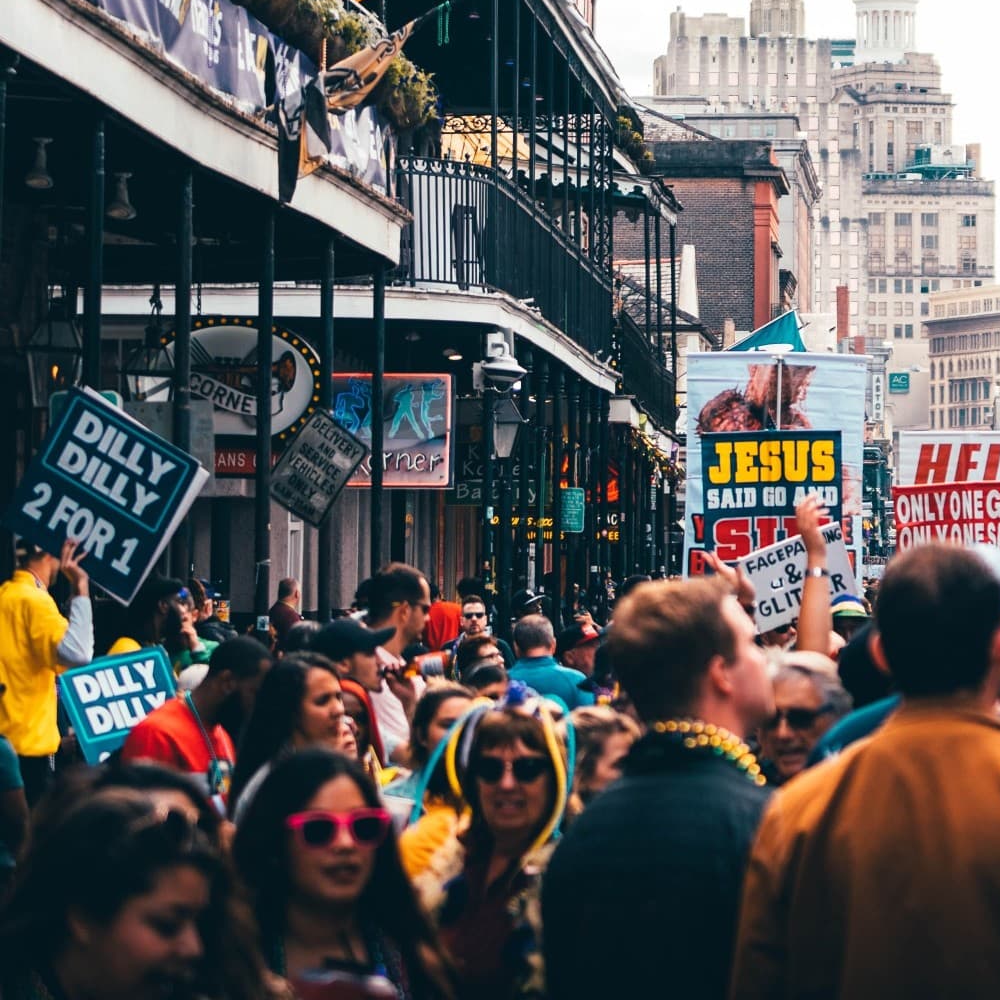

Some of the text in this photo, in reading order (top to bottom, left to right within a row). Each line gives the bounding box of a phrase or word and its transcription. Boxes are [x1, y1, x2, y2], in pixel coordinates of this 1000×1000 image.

[190, 373, 253, 414] CORNE
[892, 375, 908, 384] AC
[72, 410, 176, 485] DILLY
[311, 417, 359, 459] DELIVERY
[318, 442, 336, 459] AND
[57, 441, 160, 516] DILLY
[288, 451, 336, 497] VEHICLES
[299, 442, 341, 479] SERVICE
[708, 440, 835, 484] JESUS
[287, 474, 315, 499] ONLY
[707, 487, 757, 509] SAID
[762, 486, 787, 507] GO
[896, 492, 946, 523] ONLY
[950, 490, 983, 521] ONE
[22, 482, 139, 576] 2 FOR 1
[746, 526, 842, 574] FACEPAING
[758, 573, 847, 617] GLITR
[784, 563, 802, 585] &
[72, 659, 156, 704] DILLY
